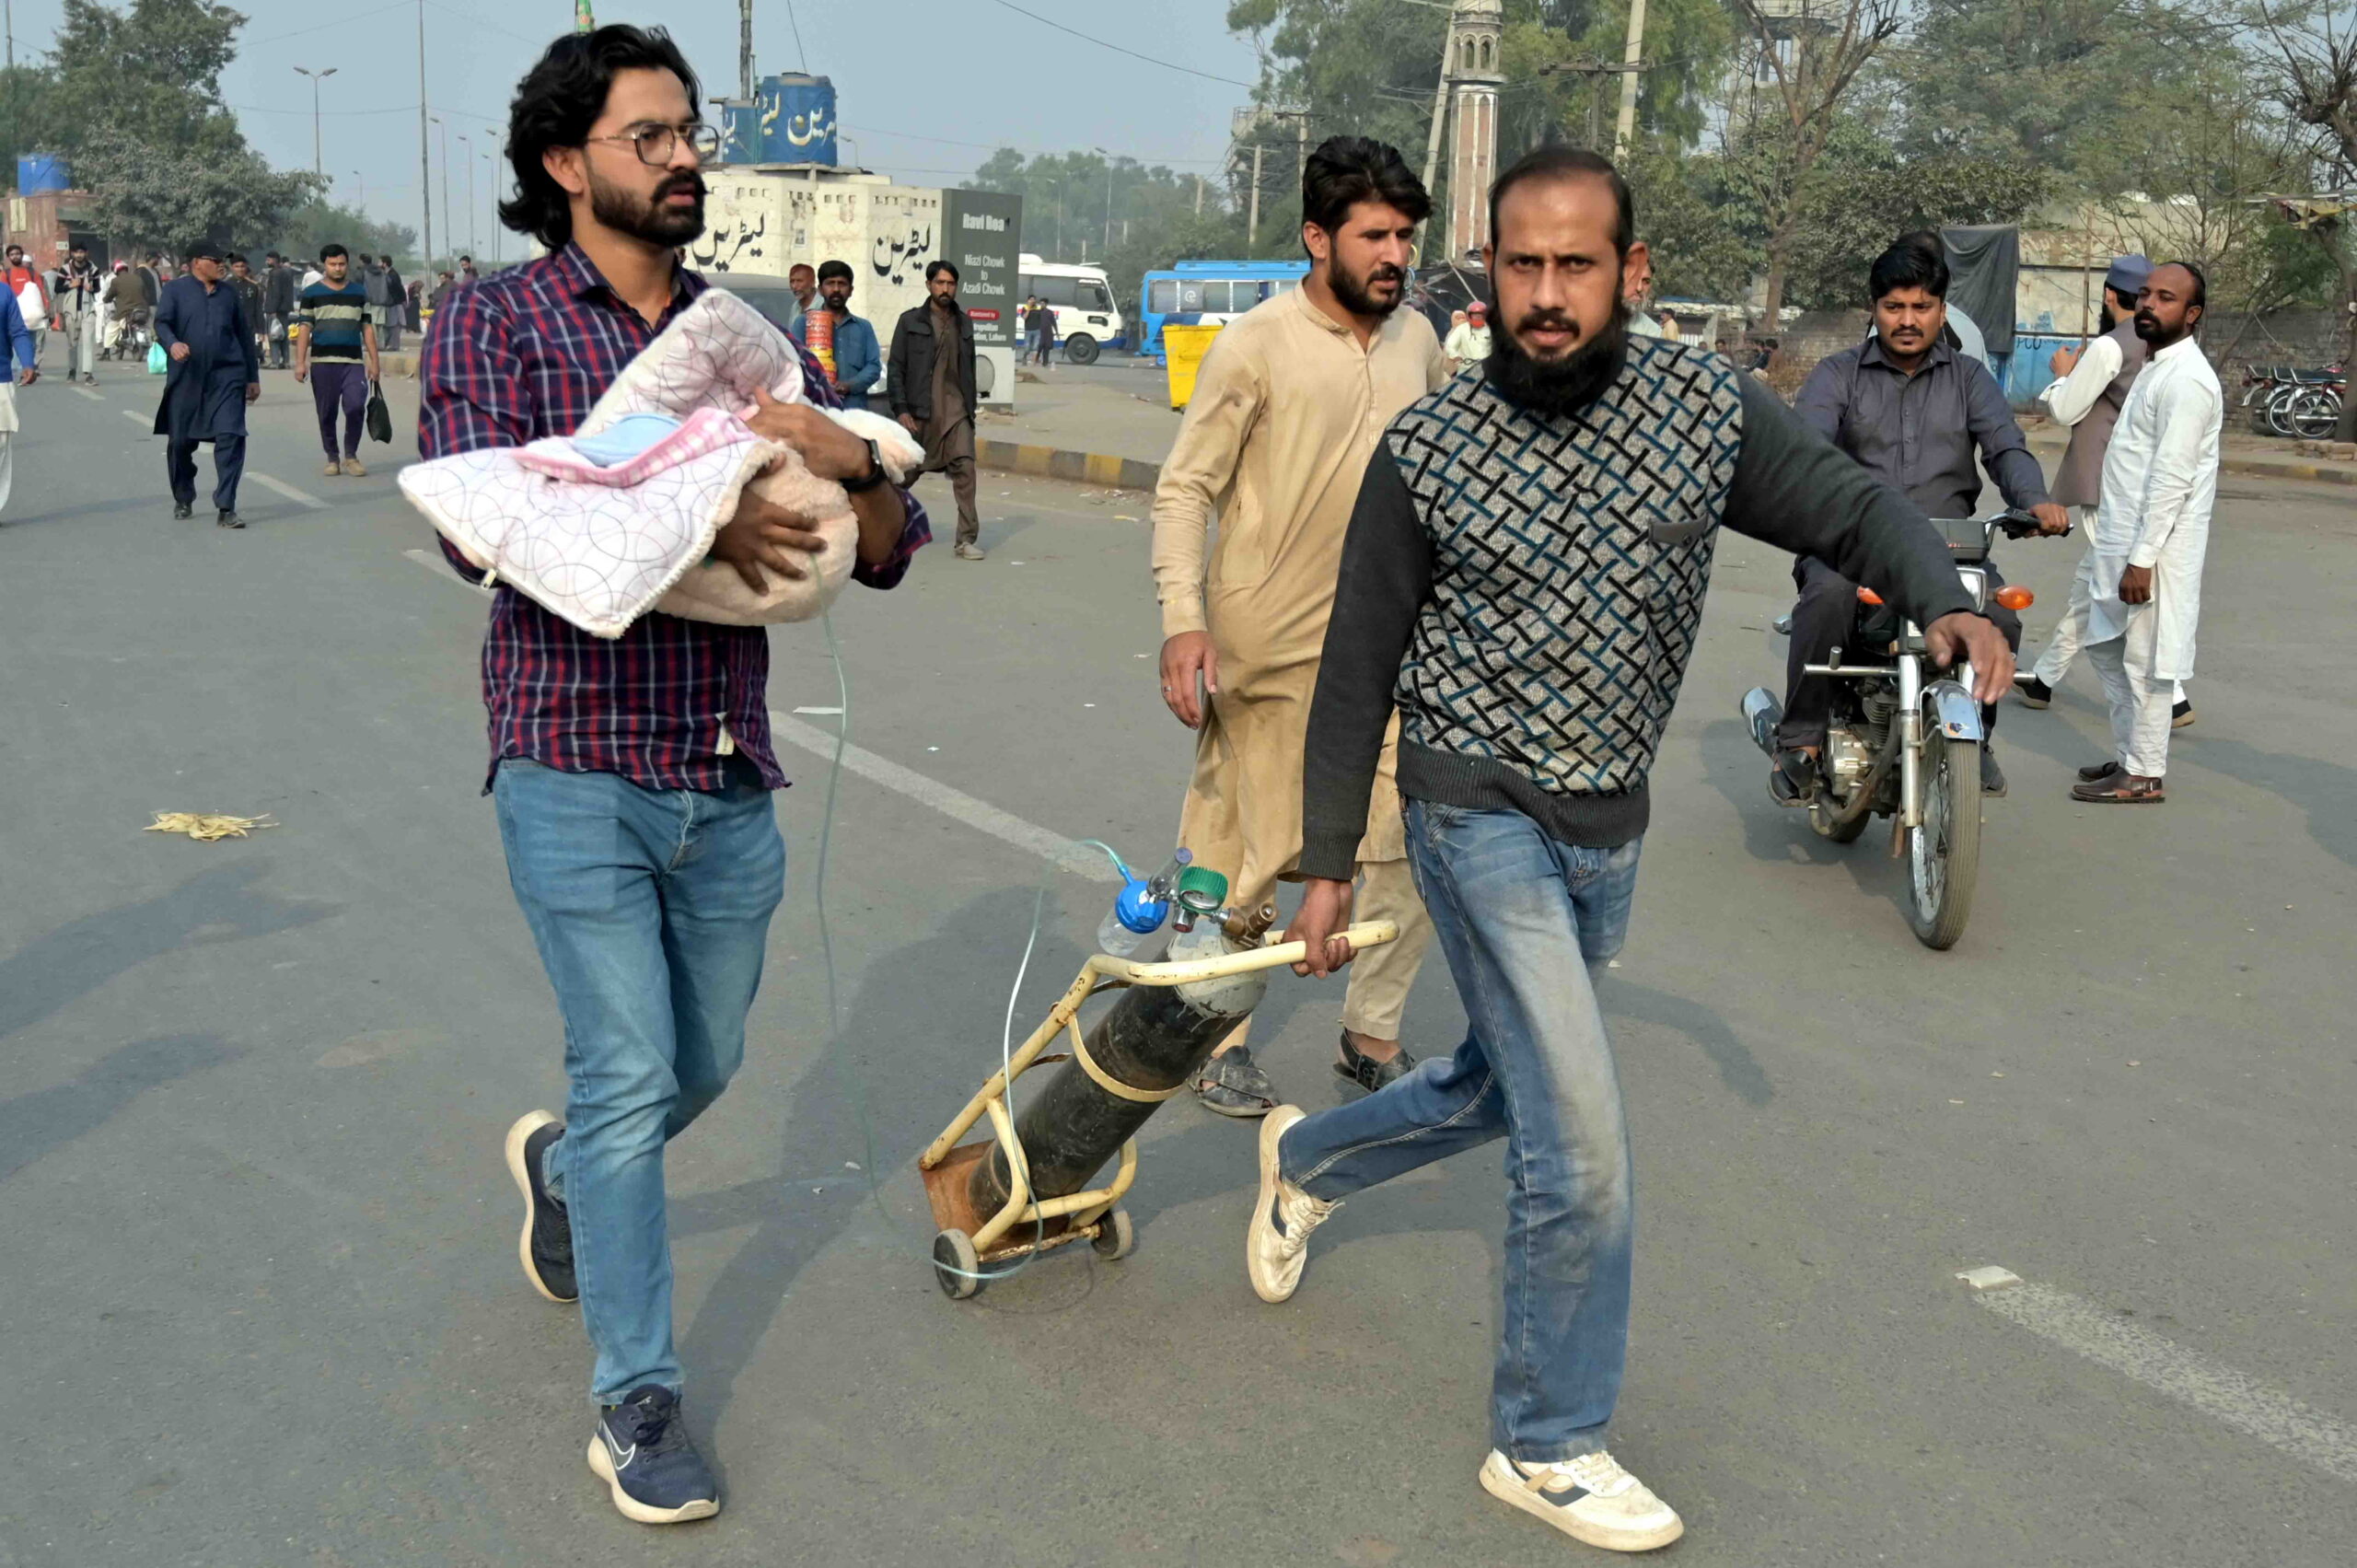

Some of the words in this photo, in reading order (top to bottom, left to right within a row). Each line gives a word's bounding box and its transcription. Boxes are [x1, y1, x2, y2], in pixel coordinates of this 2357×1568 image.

[962, 213, 984, 229] Ravi
[986, 215, 1006, 231] Roa
[982, 254, 1005, 268] Chowk
[981, 269, 989, 281] to
[962, 282, 981, 295] Azadi
[982, 283, 1005, 296] Chowk
